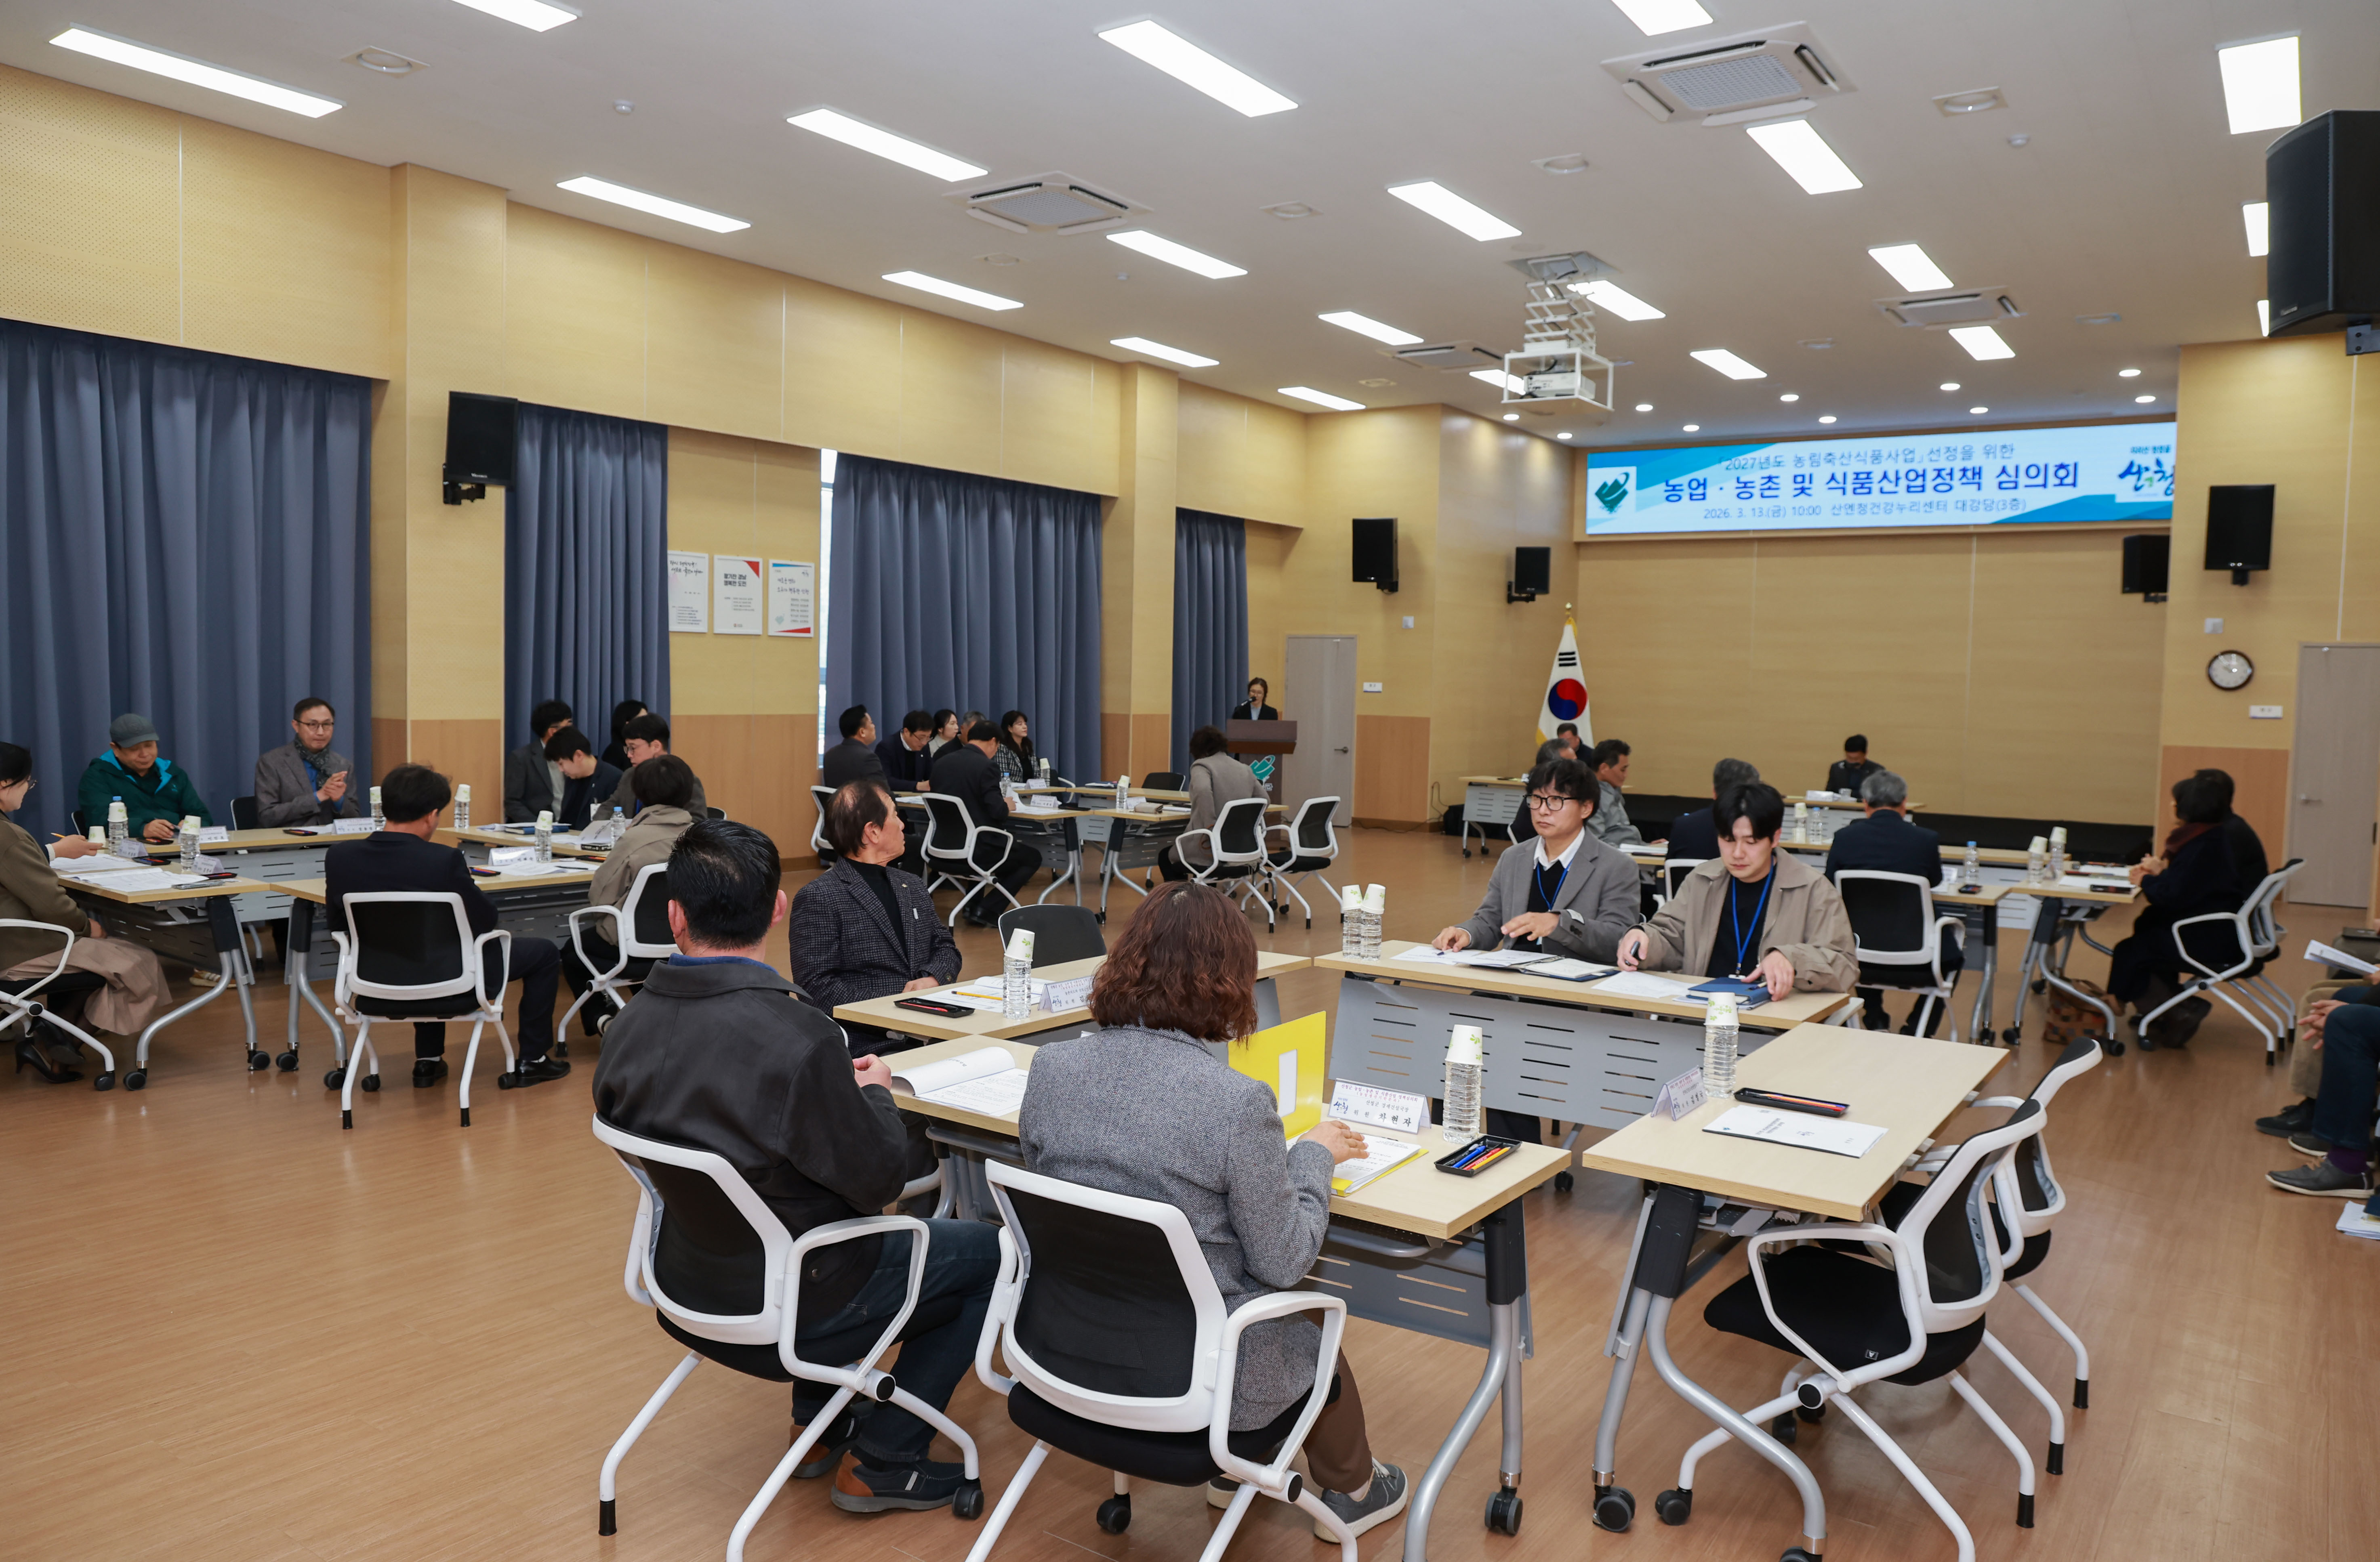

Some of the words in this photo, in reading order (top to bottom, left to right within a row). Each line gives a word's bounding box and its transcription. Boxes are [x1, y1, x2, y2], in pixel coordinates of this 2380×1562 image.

[1983, 443, 2015, 460] 위한
[1664, 477, 1707, 503] 농업
[1735, 474, 1781, 500] 농촌
[1793, 472, 1814, 498] 및
[1825, 466, 1983, 496] 식품산업정책
[1996, 462, 2079, 490] 심의회
[1703, 508, 1732, 519] 2026.
[1737, 508, 1746, 518] 3.
[1792, 505, 1822, 517] 10:00
